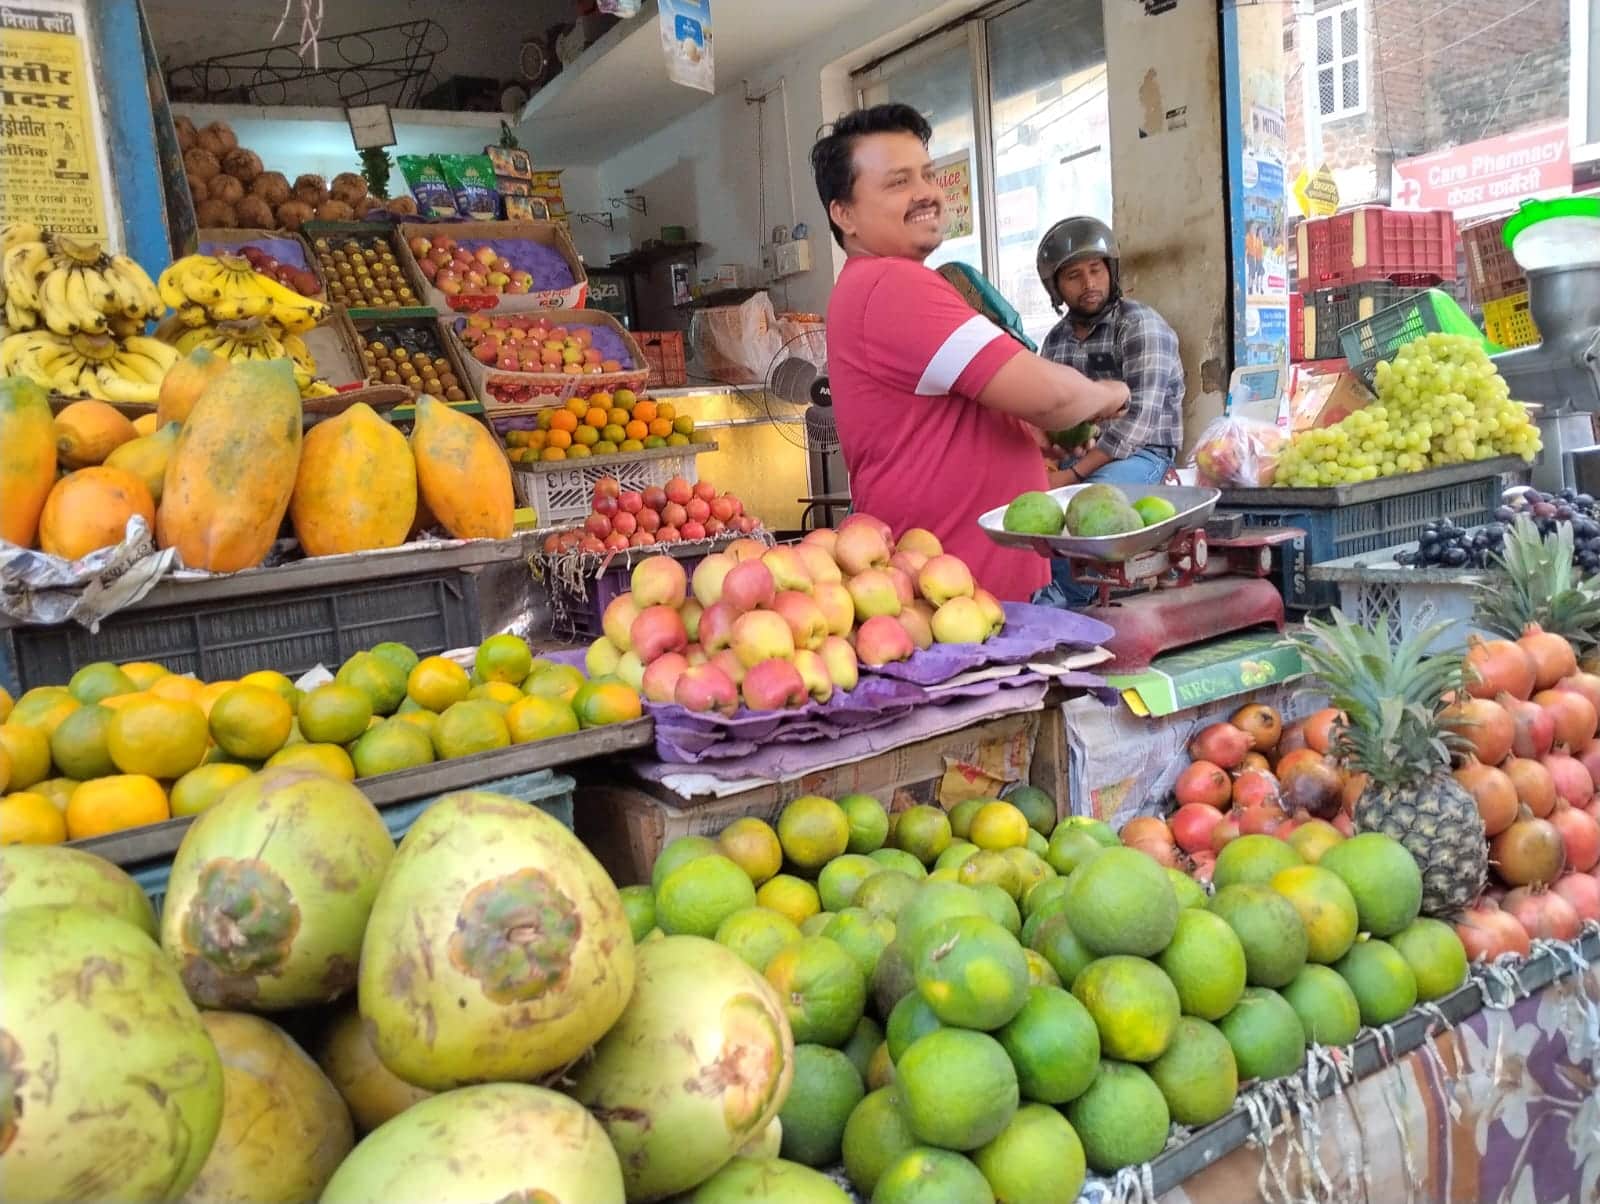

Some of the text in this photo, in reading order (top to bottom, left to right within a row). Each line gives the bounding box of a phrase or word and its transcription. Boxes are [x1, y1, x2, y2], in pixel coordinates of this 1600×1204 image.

[936, 170, 960, 189] uice
[1429, 141, 1564, 186] Care Pharmacy
